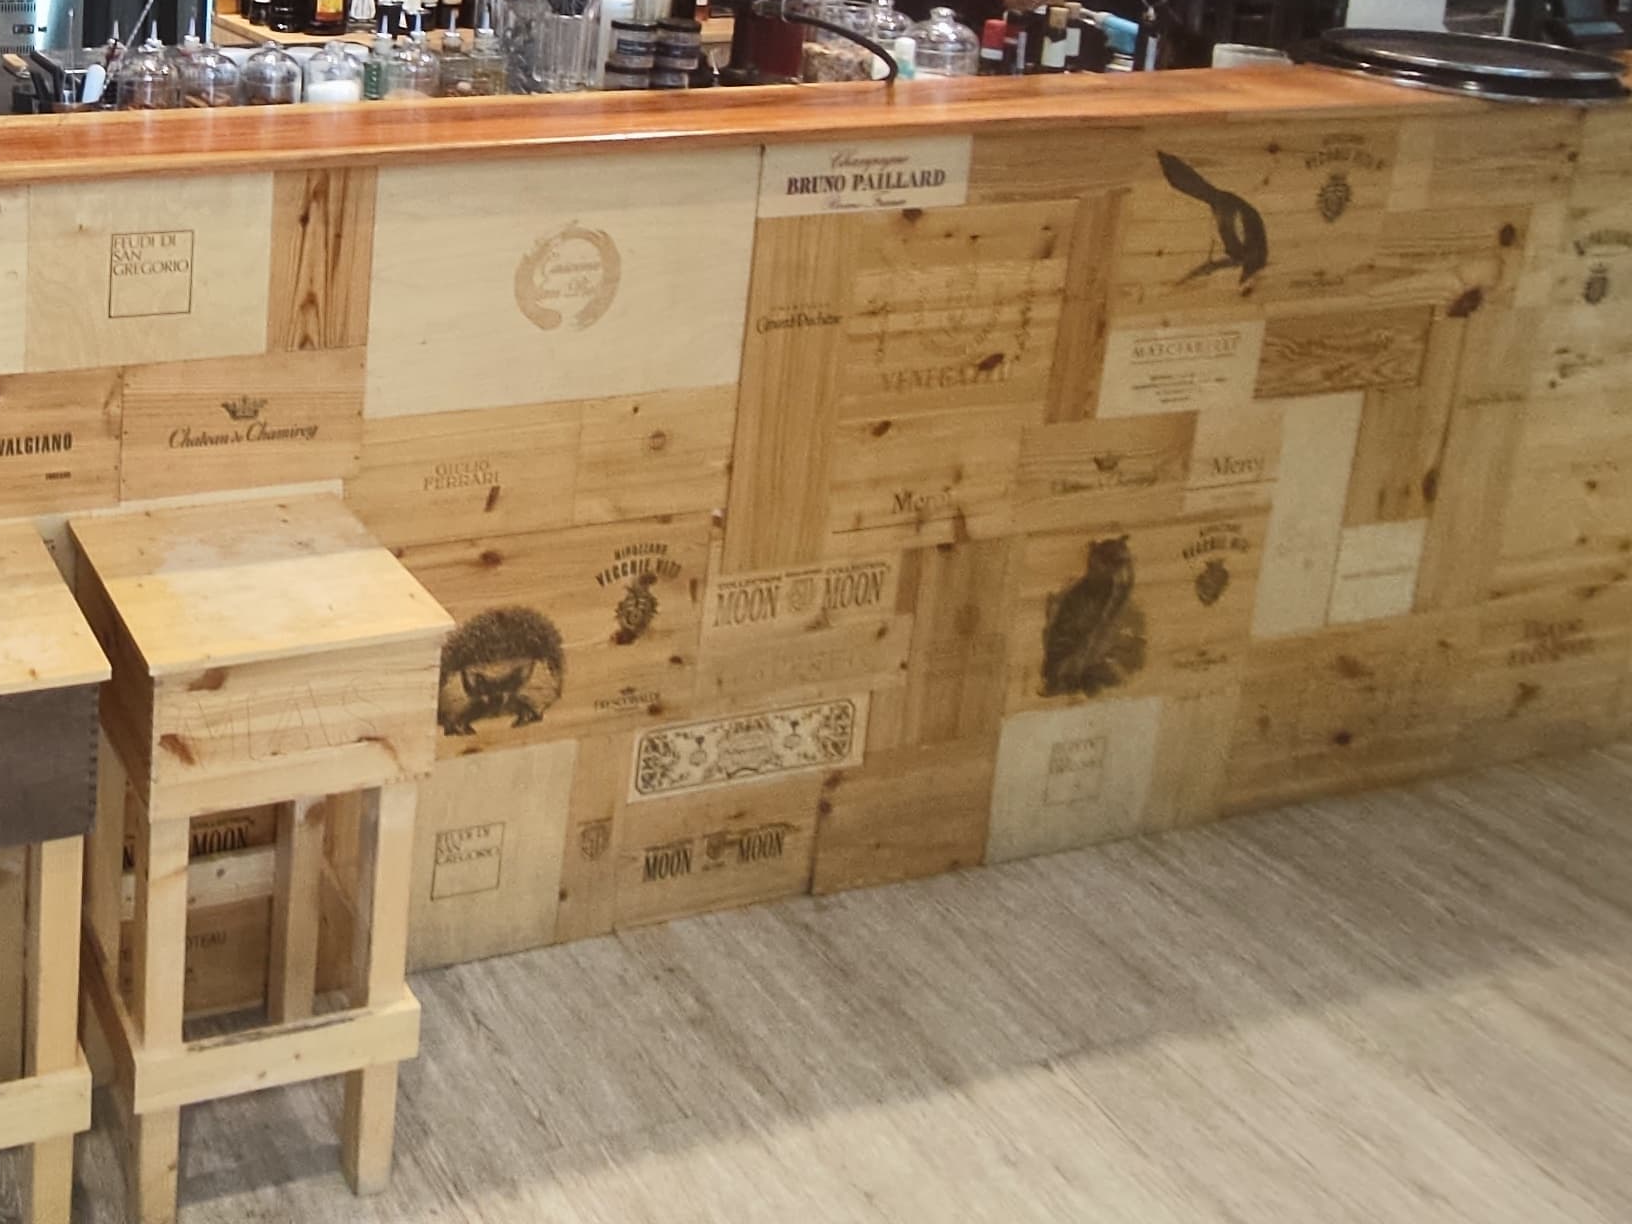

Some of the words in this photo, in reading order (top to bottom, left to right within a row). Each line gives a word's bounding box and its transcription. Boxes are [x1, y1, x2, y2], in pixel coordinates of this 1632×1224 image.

[786, 174, 846, 195] BRUNO
[851, 169, 945, 192] PAILLARD
[161, 233, 176, 248] DI
[112, 249, 142, 262] SAN
[112, 259, 189, 277] GREGORIO
[434, 459, 490, 476] GIULIO
[423, 471, 499, 491] FERRARI
[712, 584, 781, 628] MOON
[823, 569, 886, 610] MOON
[190, 824, 250, 856] MOON
[642, 846, 693, 883] MOON
[736, 829, 786, 864] MOON
